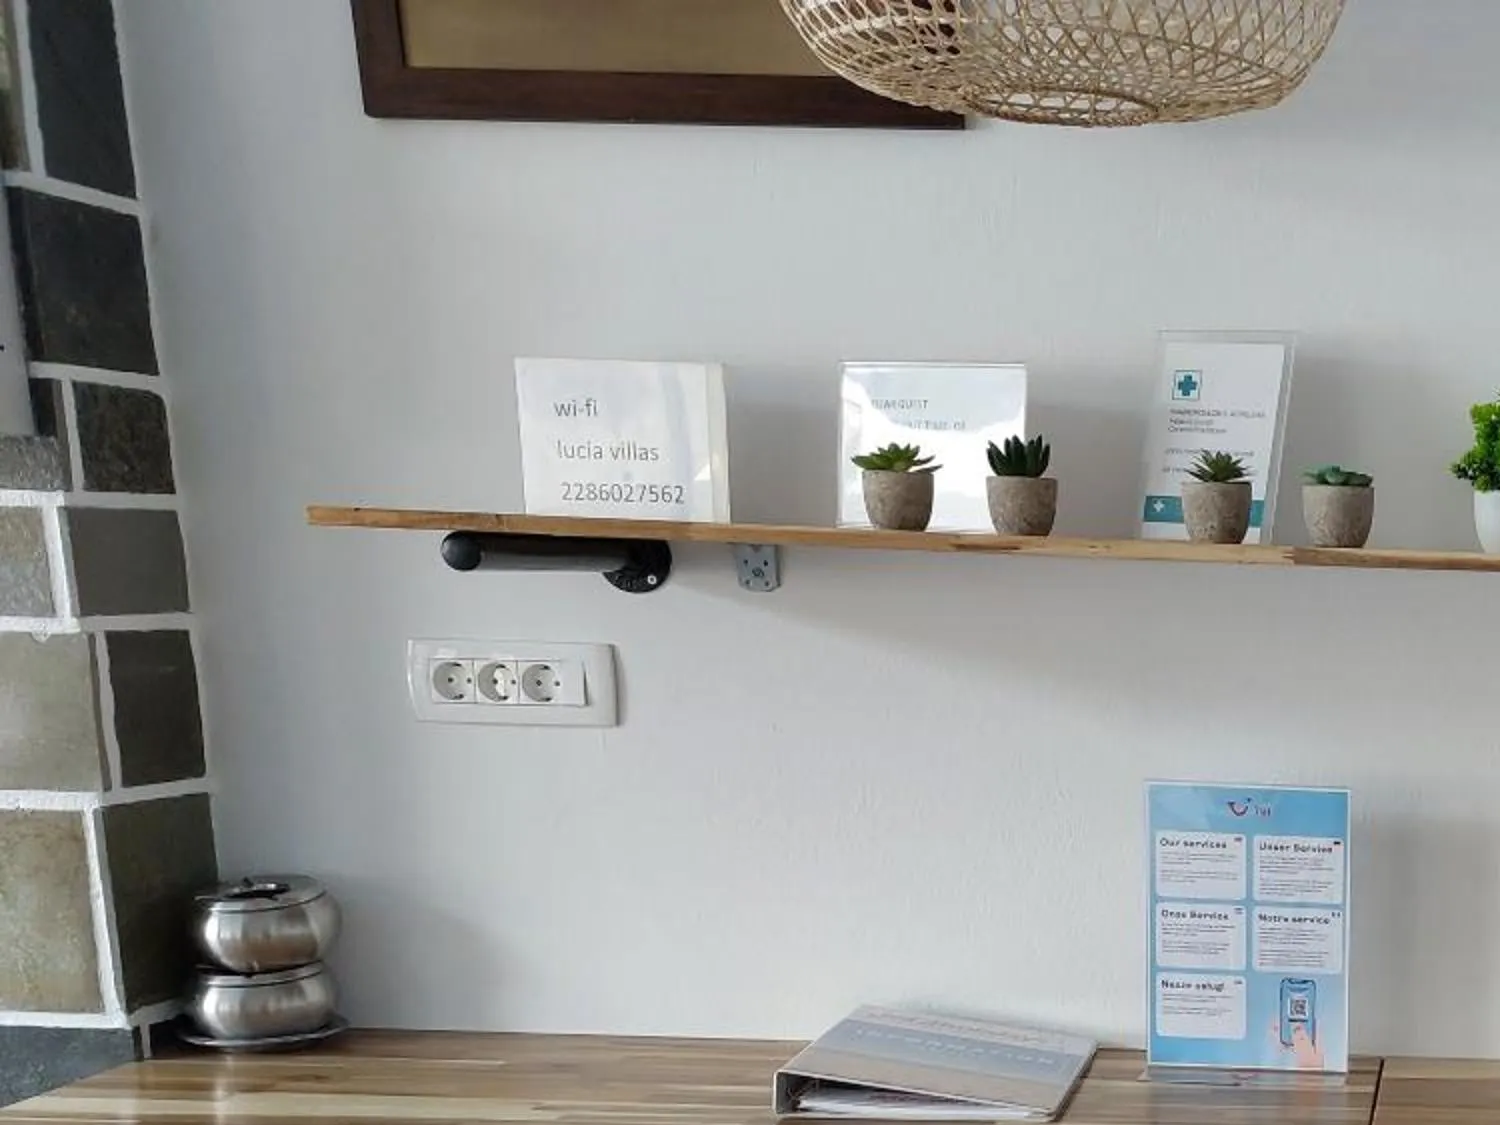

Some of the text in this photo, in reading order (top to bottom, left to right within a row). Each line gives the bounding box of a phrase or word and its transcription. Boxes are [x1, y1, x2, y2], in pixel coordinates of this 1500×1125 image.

[553, 399, 598, 417] wi-fi
[557, 440, 660, 461] lucia villas
[561, 482, 685, 504] 2286027562
[1159, 837, 1227, 849] Our services
